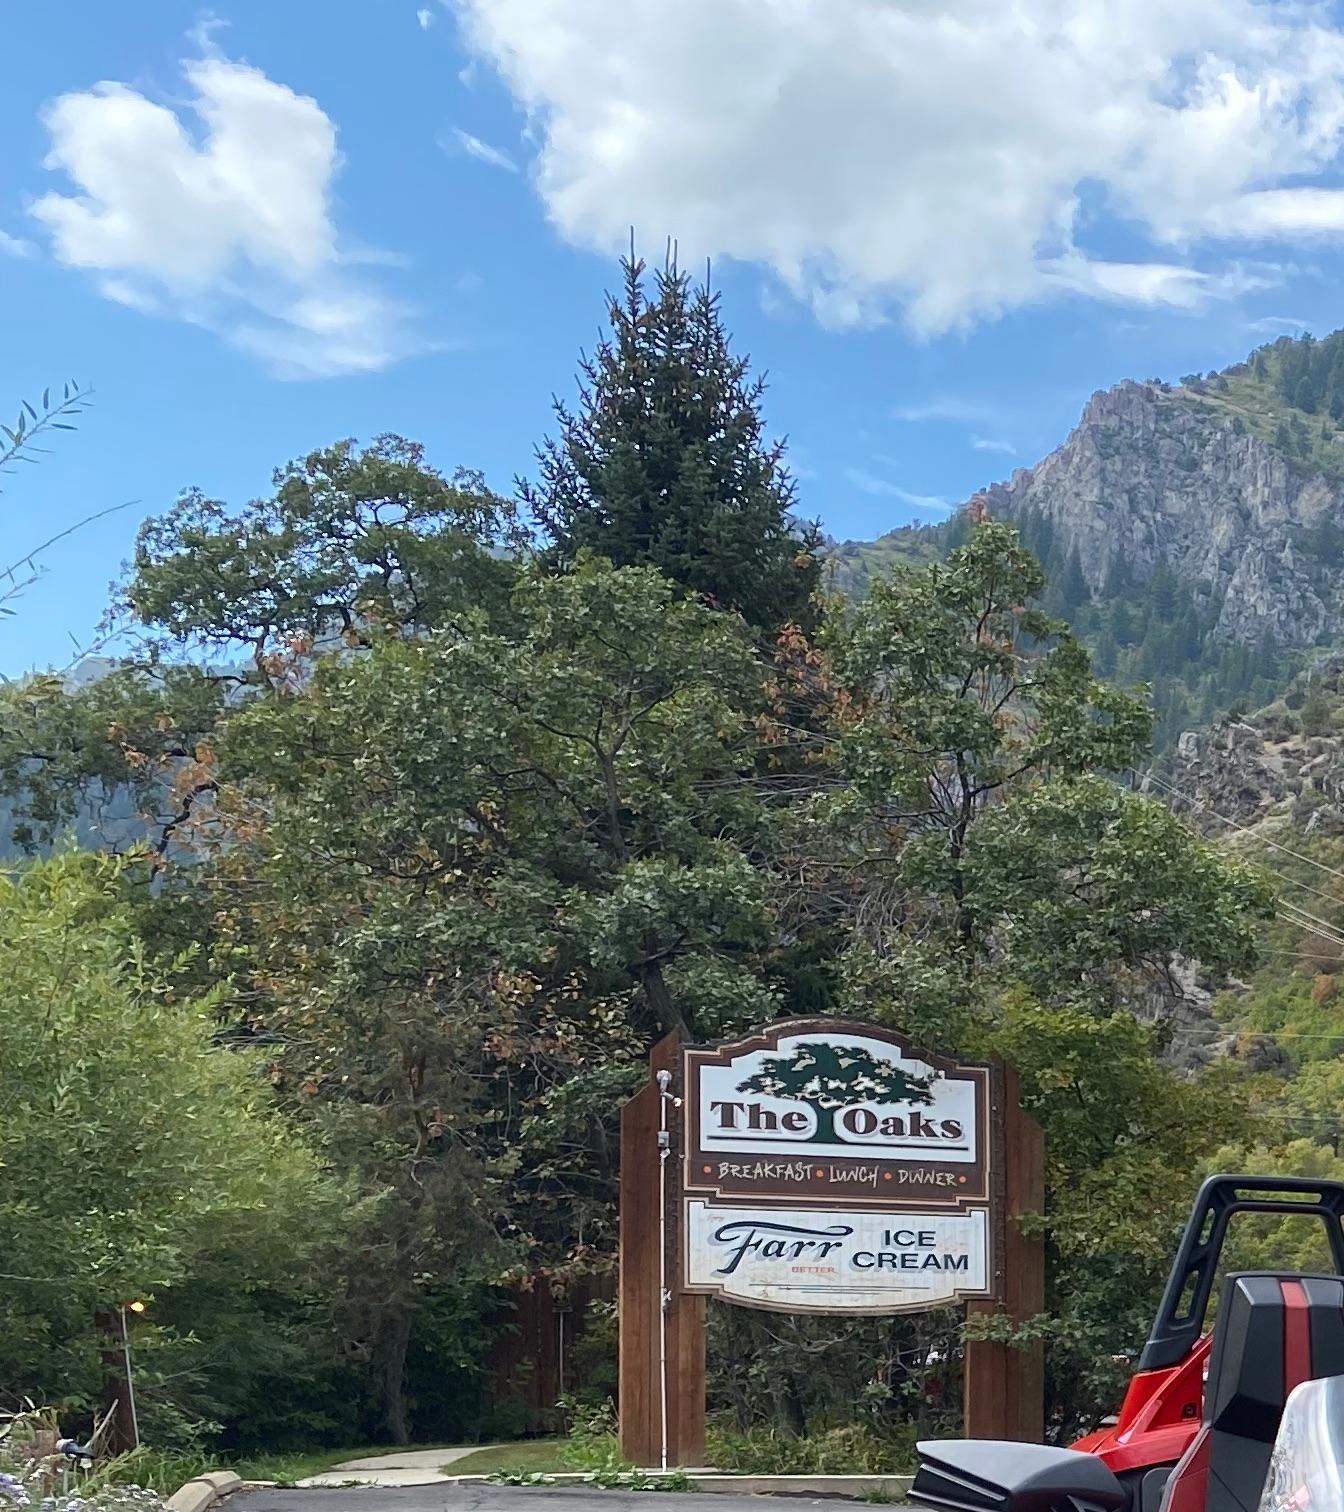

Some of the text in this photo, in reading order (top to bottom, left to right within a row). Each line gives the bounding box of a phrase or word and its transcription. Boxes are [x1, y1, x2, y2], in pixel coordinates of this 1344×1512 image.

[709, 1101, 963, 1139] The Oaks
[717, 1161, 958, 1188] BREAKFAST LUNCH DINNER
[714, 1221, 854, 1275] Farr
[885, 1229, 937, 1247] ICE
[852, 1251, 969, 1270] CREAM
